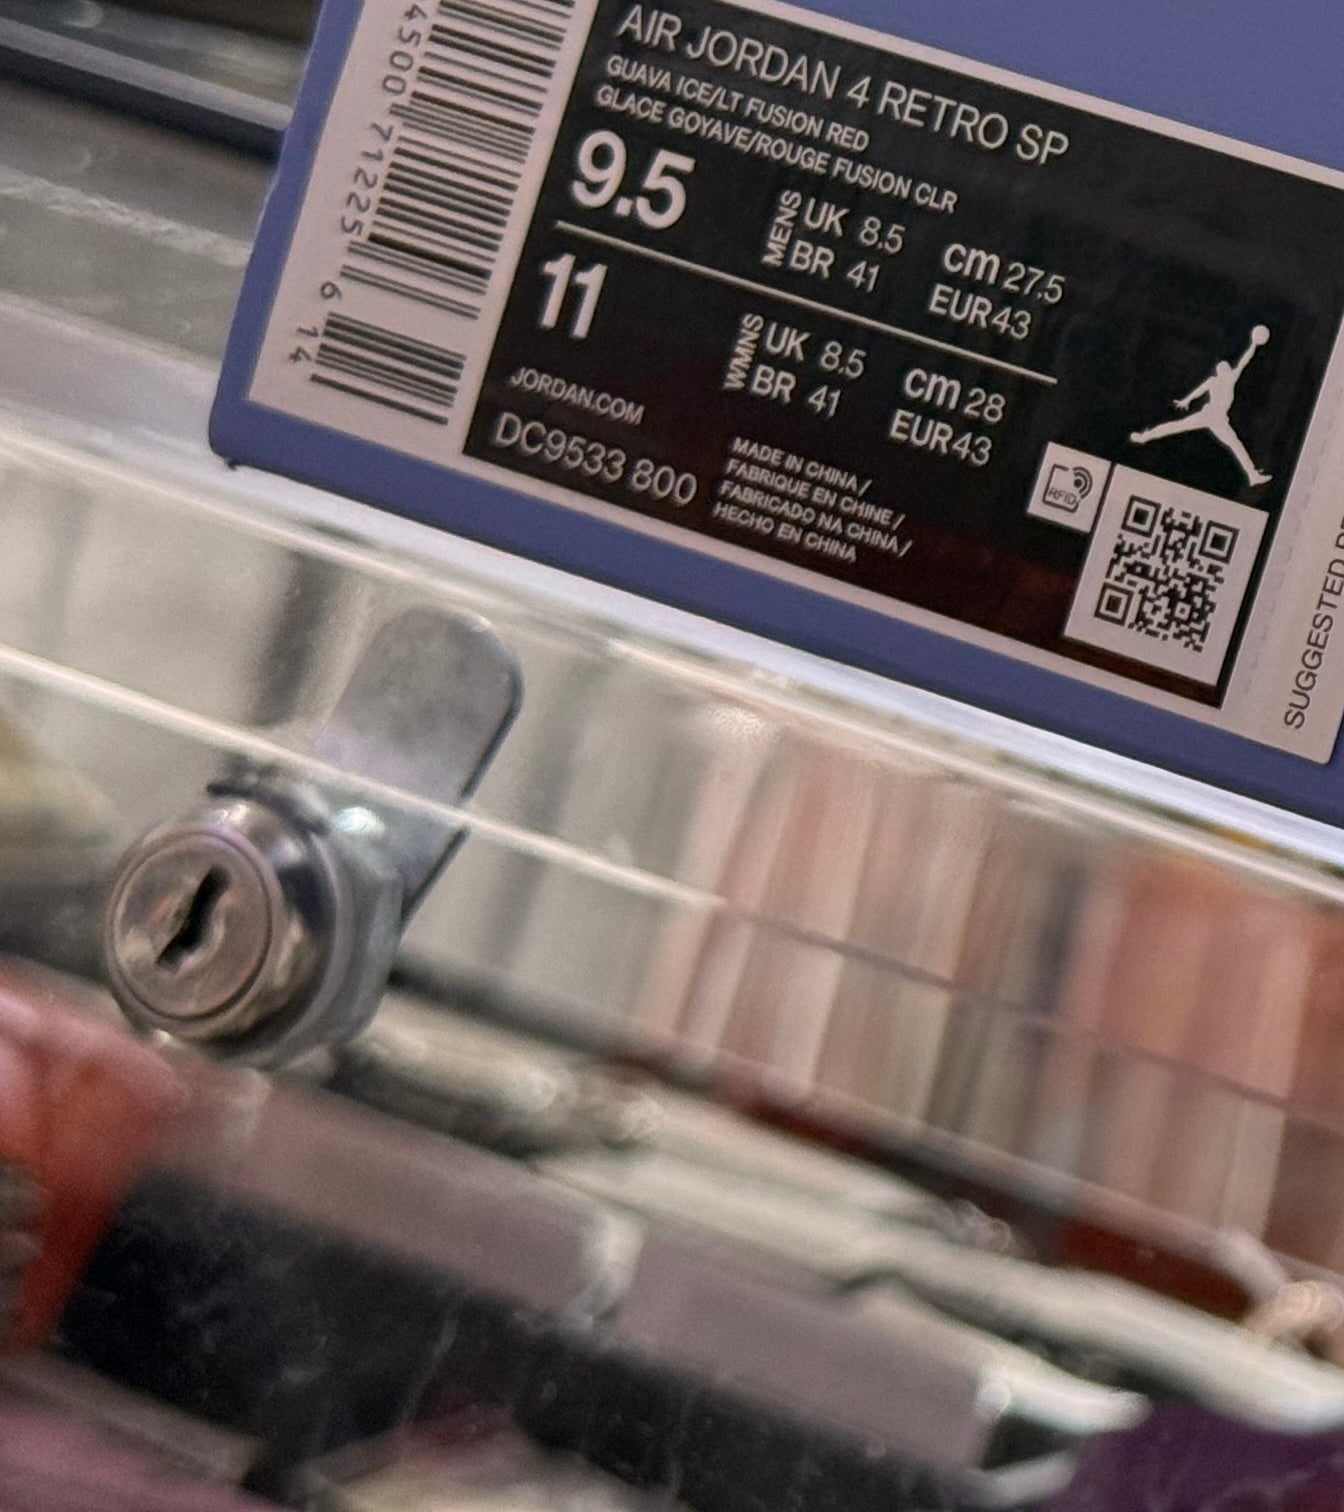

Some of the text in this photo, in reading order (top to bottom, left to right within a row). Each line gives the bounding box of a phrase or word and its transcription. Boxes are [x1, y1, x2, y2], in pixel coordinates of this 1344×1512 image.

[607, 54, 870, 152] GUAVA ICE/LT FUSION RED
[616, 3, 1069, 165] AIR JORDAN 4 RETRO SP
[597, 84, 958, 214] GLACE GOYAVE/ROUGE FUSION CLR
[572, 129, 697, 230] 9.5
[761, 189, 802, 267] MENS
[803, 197, 906, 254] UK 8.5
[320, 281, 342, 300] 6
[540, 253, 608, 339] 11
[789, 239, 881, 294] BR 41
[942, 242, 1066, 304] cm 27.5
[723, 313, 764, 390] WMNS
[764, 322, 868, 379] UK 8.5
[509, 366, 645, 425] JORDAN.COM
[751, 364, 841, 419] BR 41
[903, 367, 1006, 424] cm 28
[494, 411, 697, 505] DC9533 800
[725, 458, 812, 498] FABRIQUE
[812, 486, 838, 507] EN
[732, 437, 785, 465] MADE
[785, 456, 804, 473] IN
[713, 501, 857, 563] HECHO EN CHINA
[719, 480, 815, 524] FABRICADO
[818, 512, 843, 533] NA
